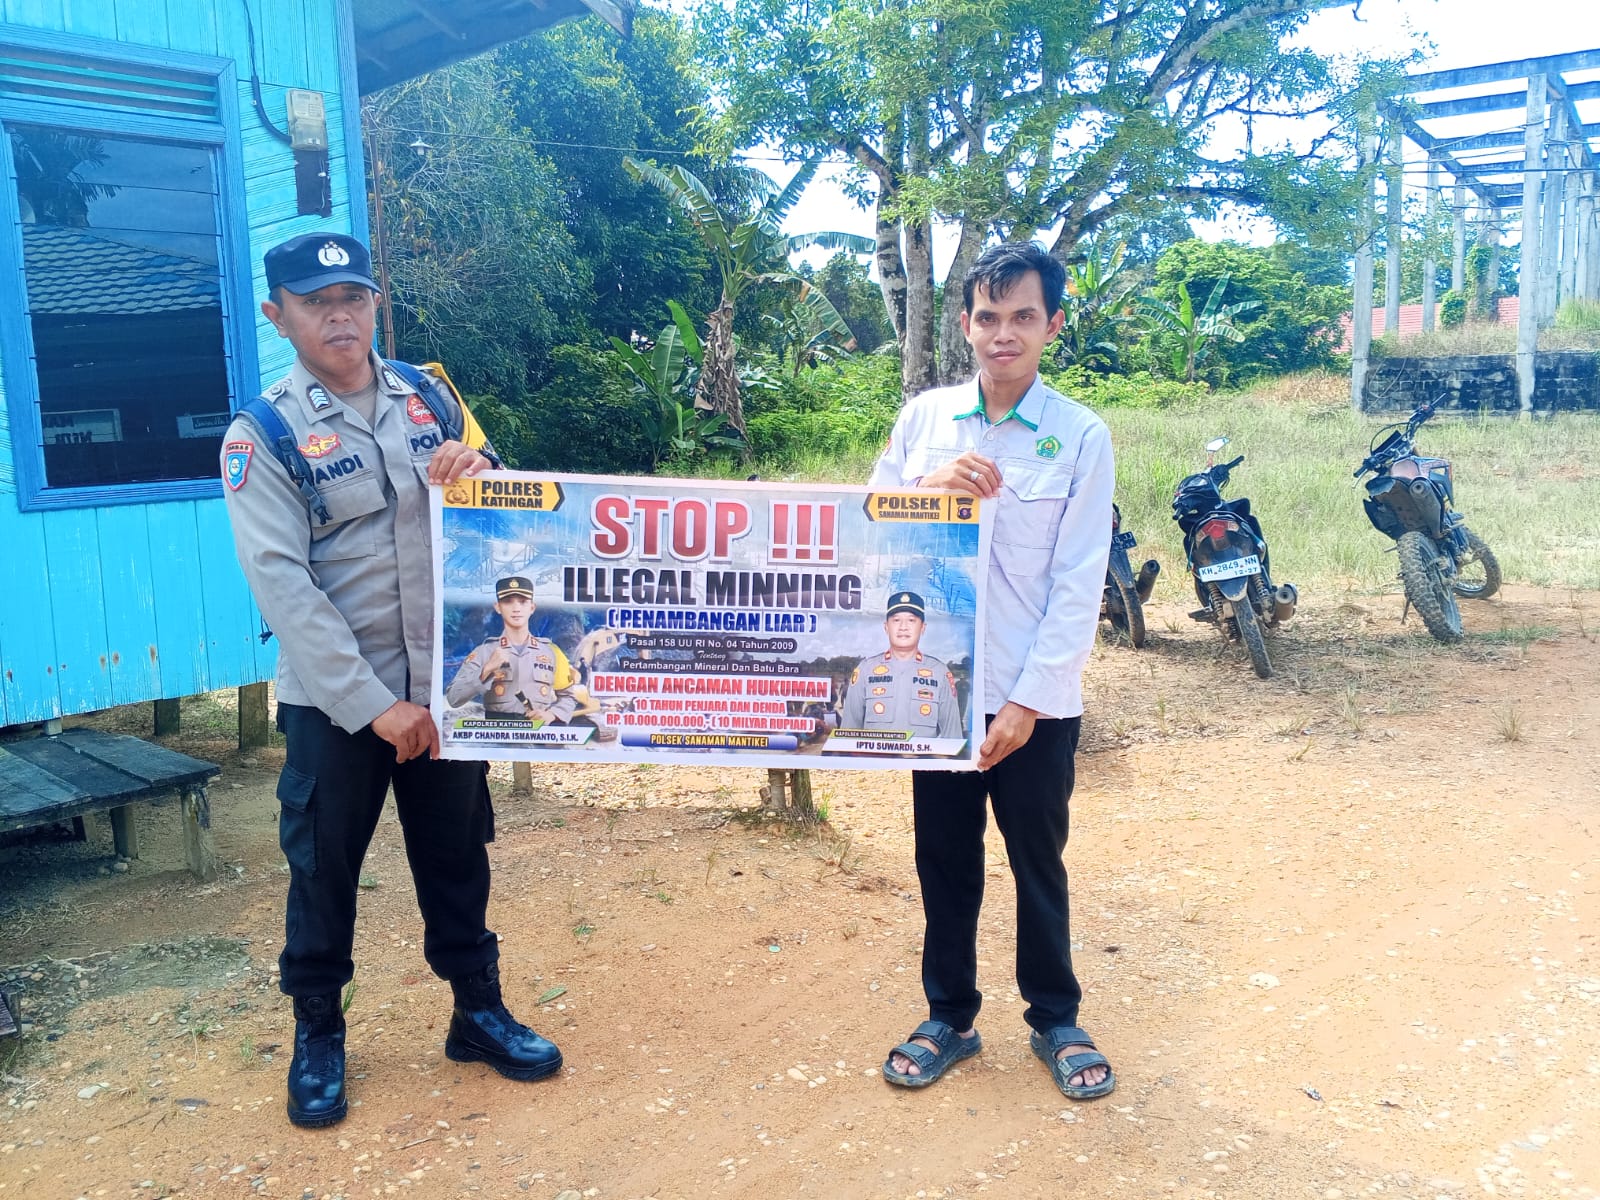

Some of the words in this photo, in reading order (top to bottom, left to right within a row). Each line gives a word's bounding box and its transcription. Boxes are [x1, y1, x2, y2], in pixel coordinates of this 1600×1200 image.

[410, 432, 443, 453] POL
[315, 454, 364, 485] ANDI
[481, 480, 543, 497] POLRES
[481, 496, 543, 509] KATINGAN
[877, 496, 941, 511] POLSEK
[592, 495, 751, 559] STOP
[771, 503, 835, 561] !!!
[563, 566, 697, 605] ILLEGAL
[705, 571, 863, 611] MINNING
[630, 637, 657, 647] Pasal
[659, 638, 676, 647] 158
[678, 639, 693, 648] UU
[695, 640, 705, 648] RI
[708, 640, 724, 649] No.
[726, 640, 737, 649] 04
[740, 640, 769, 650] Tahun
[771, 641, 794, 650] 2009
[697, 650, 726, 661] Tentang
[623, 660, 692, 672] Pertambangan
[694, 662, 729, 672] Mineral
[731, 663, 750, 672] Dan
[753, 664, 775, 673] Batu
[777, 665, 800, 674] Bara
[594, 675, 659, 694] DENGAN
[662, 677, 743, 695] ANCAMAN
[746, 678, 828, 698] HUKUMAN
[635, 699, 648, 711] 10
[650, 699, 683, 712] TAHUN
[685, 700, 728, 713] PENJARA
[730, 701, 751, 713] DAN
[752, 701, 786, 714] DENDA
[606, 713, 621, 726] RP.
[731, 717, 768, 729] MILYAR
[452, 731, 474, 740] AKBP
[474, 731, 511, 740] CHANDRA
[512, 732, 559, 742] ISMAWANTO,
[651, 733, 683, 745] POLSEK
[684, 734, 725, 746] SANAMAN
[727, 736, 769, 747] MANTIKEI
[856, 741, 875, 750] IPTU
[876, 742, 915, 753] SUWARDI,
[916, 744, 933, 752] S.H.
